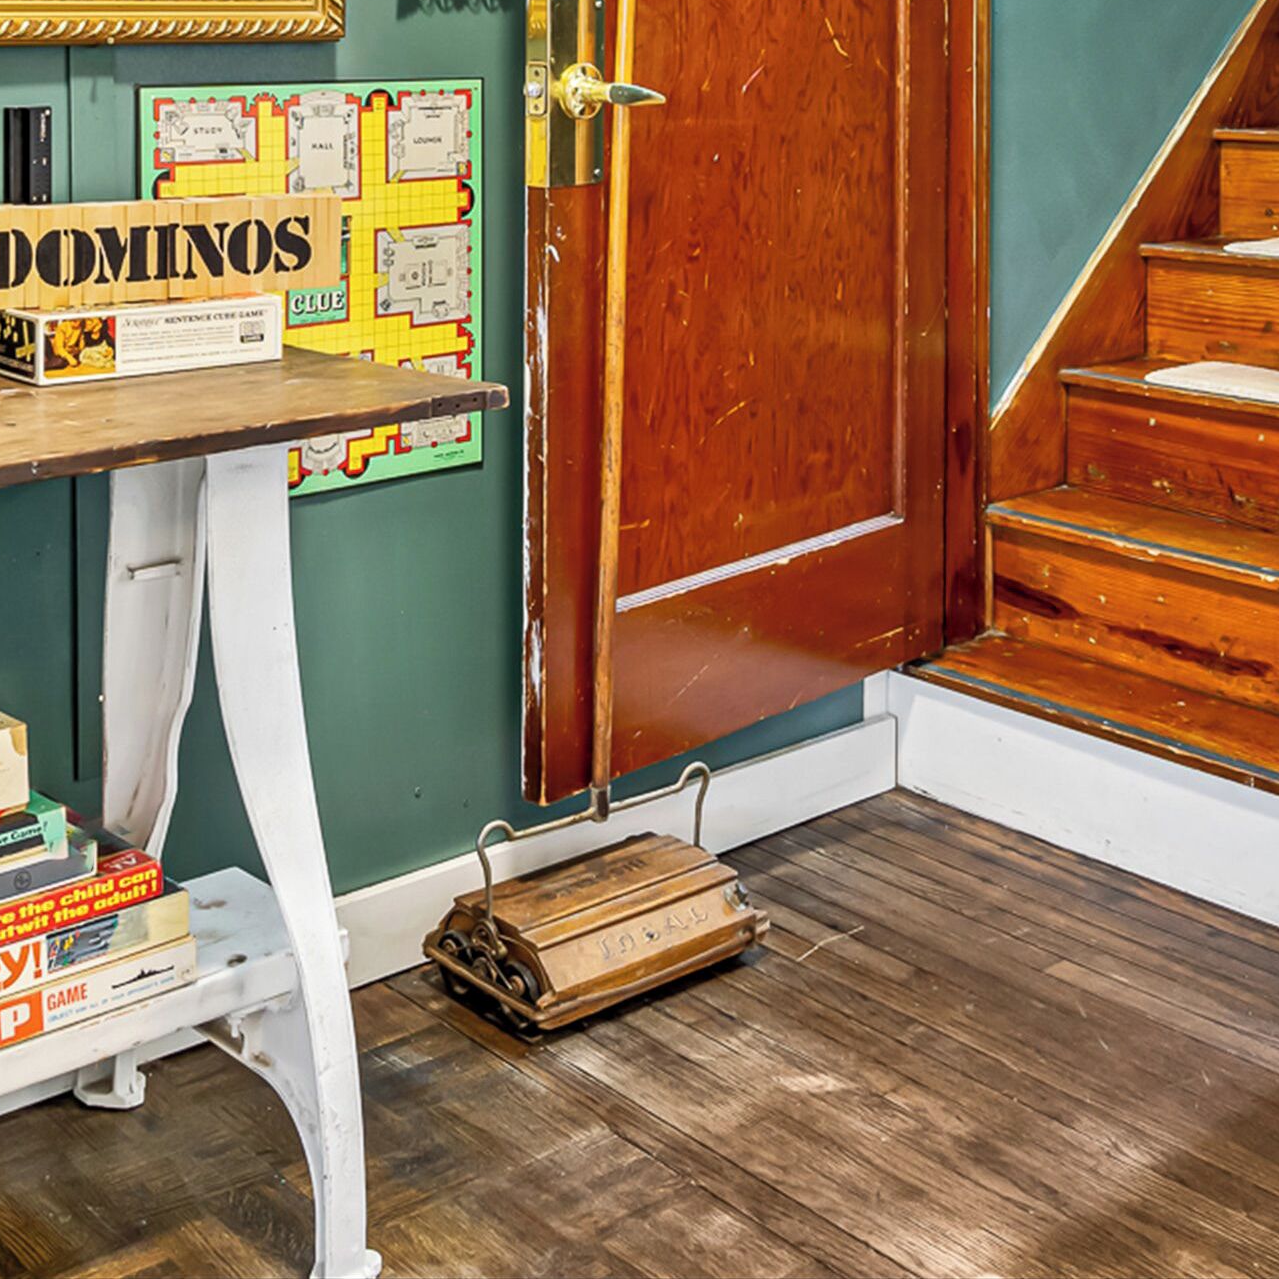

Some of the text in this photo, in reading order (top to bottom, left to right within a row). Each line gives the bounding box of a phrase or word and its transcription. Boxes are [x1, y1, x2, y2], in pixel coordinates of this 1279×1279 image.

[291, 290, 345, 316] CLUE
[18, 896, 55, 919] the
[59, 877, 115, 906] child
[118, 868, 158, 888] can
[54, 902, 89, 924] the
[47, 982, 87, 1011] GAME
